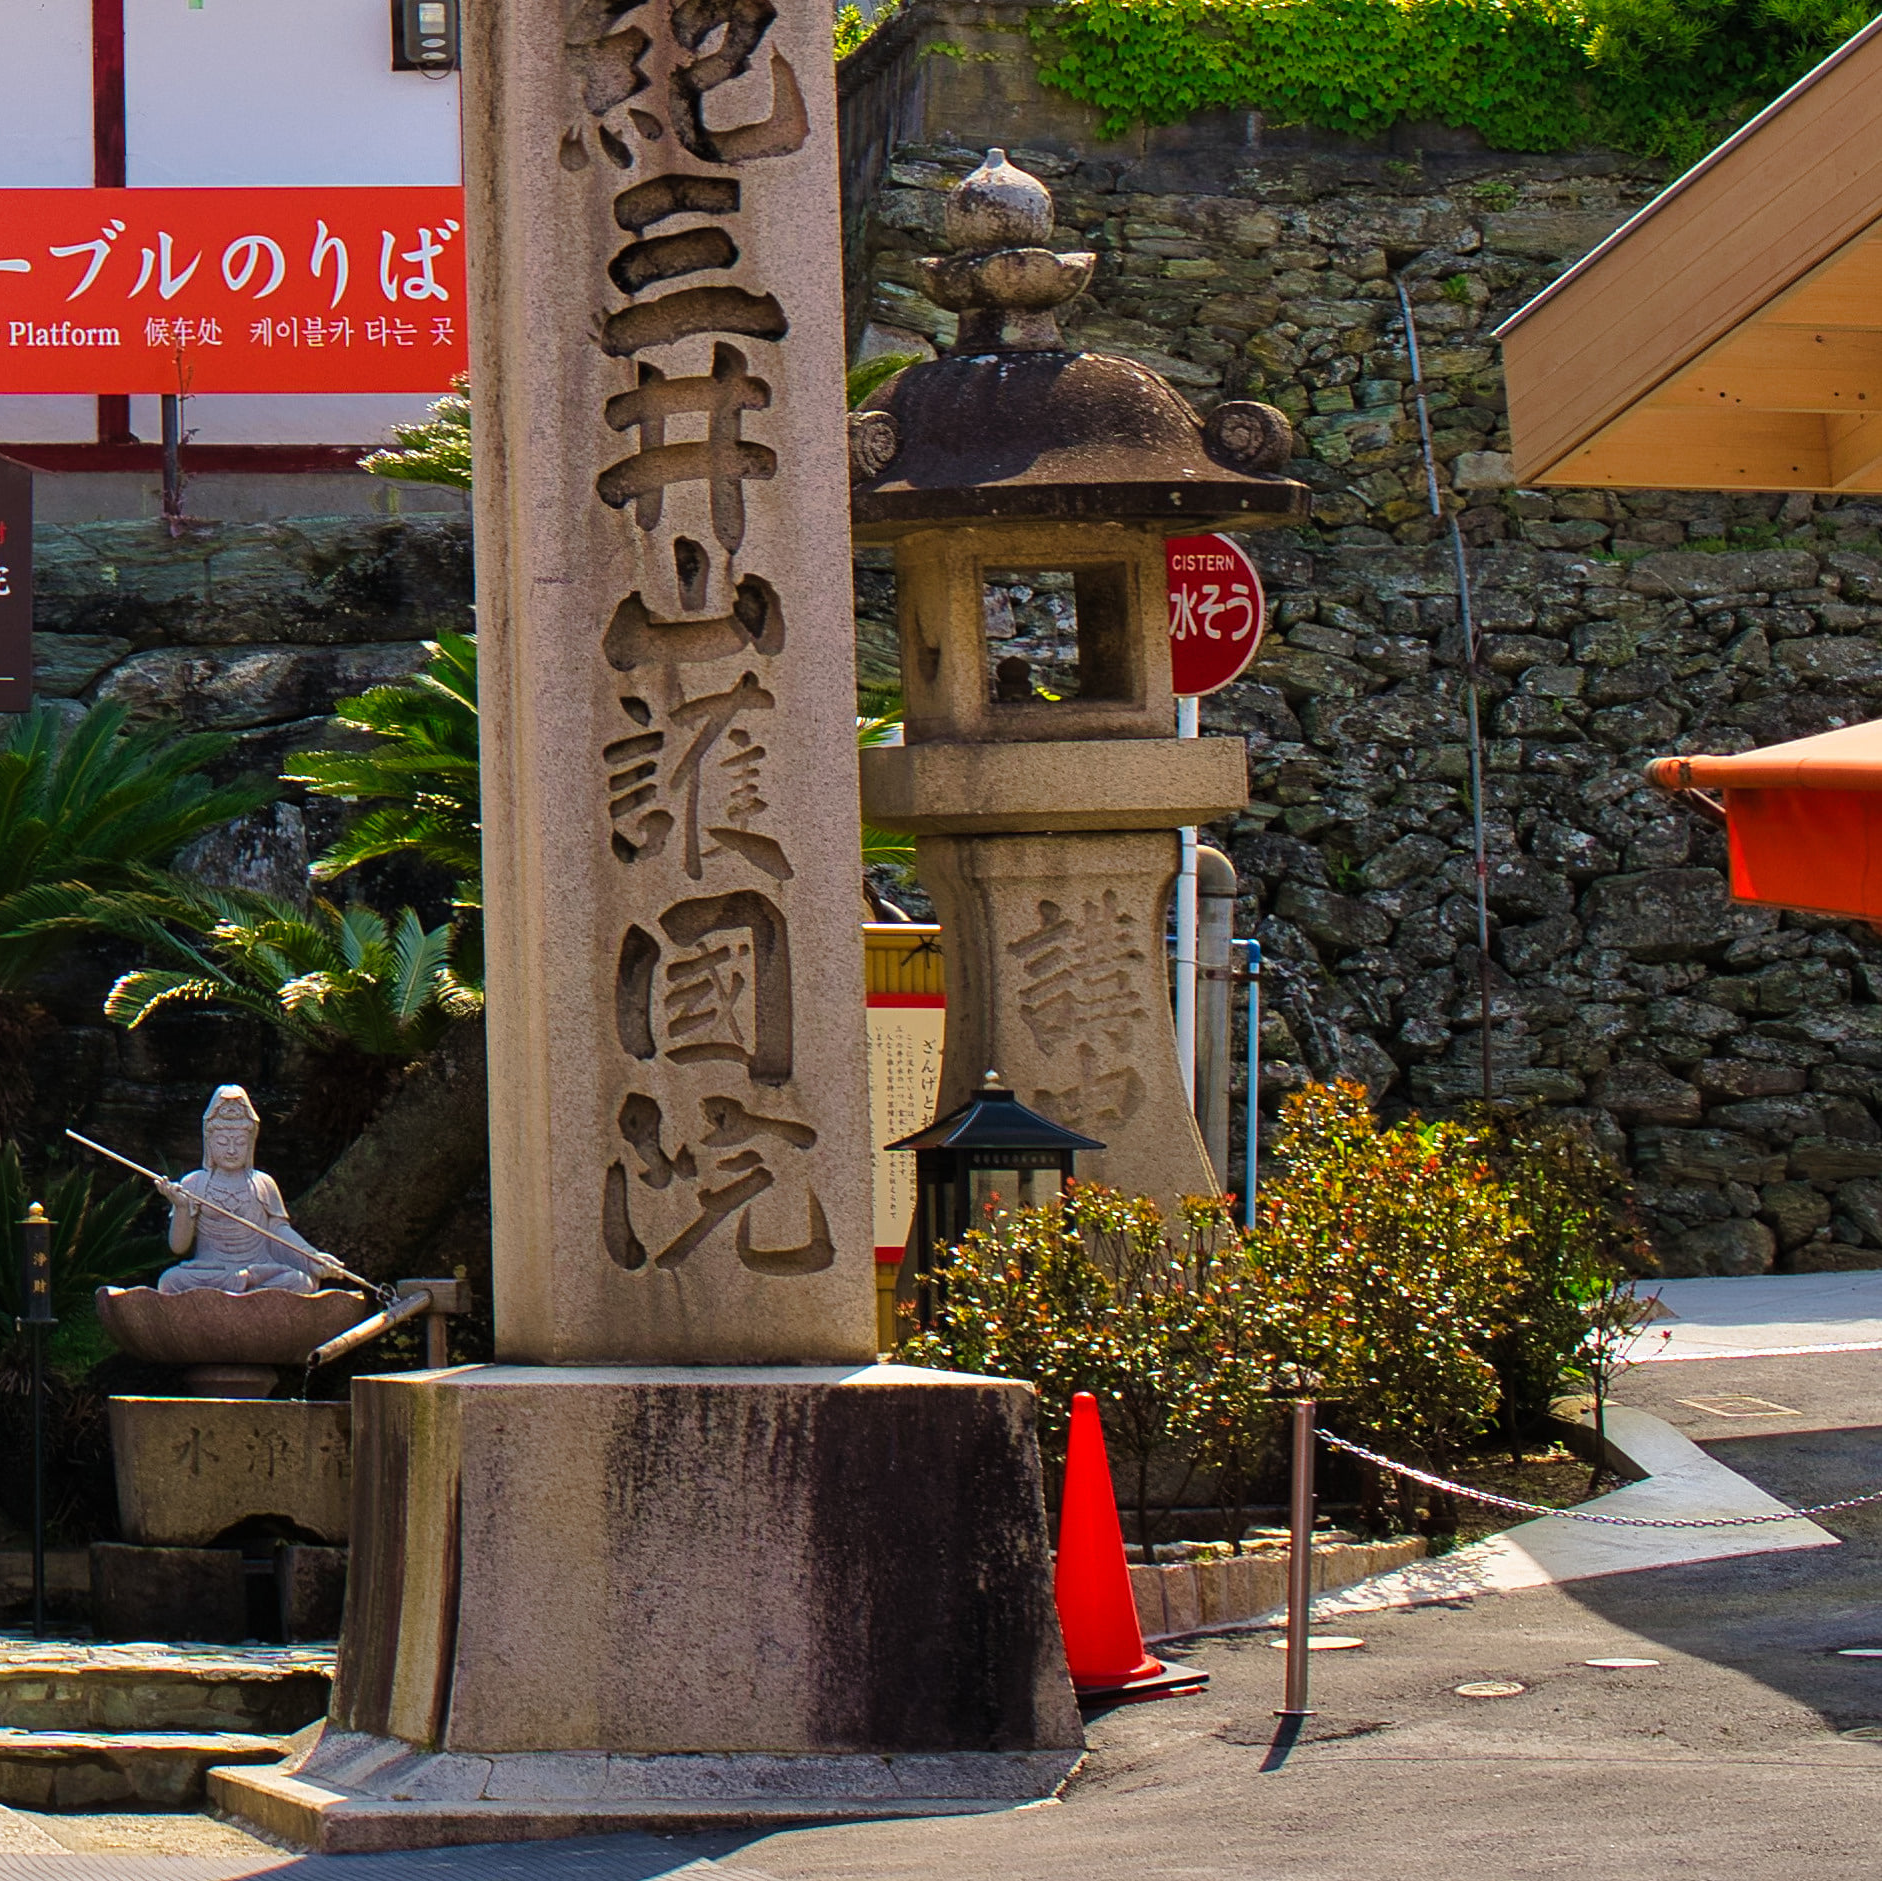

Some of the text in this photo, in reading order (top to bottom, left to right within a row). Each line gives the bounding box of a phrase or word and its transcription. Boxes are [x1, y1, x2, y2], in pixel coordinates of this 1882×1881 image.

[9, 322, 120, 346] Platform
[144, 316, 223, 347] 候车处
[249, 316, 354, 348] 케이블카
[365, 318, 417, 347] 타는
[429, 318, 454, 346] 곳
[1172, 555, 1234, 571] CISTERN
[1168, 583, 1253, 641] 水そう
